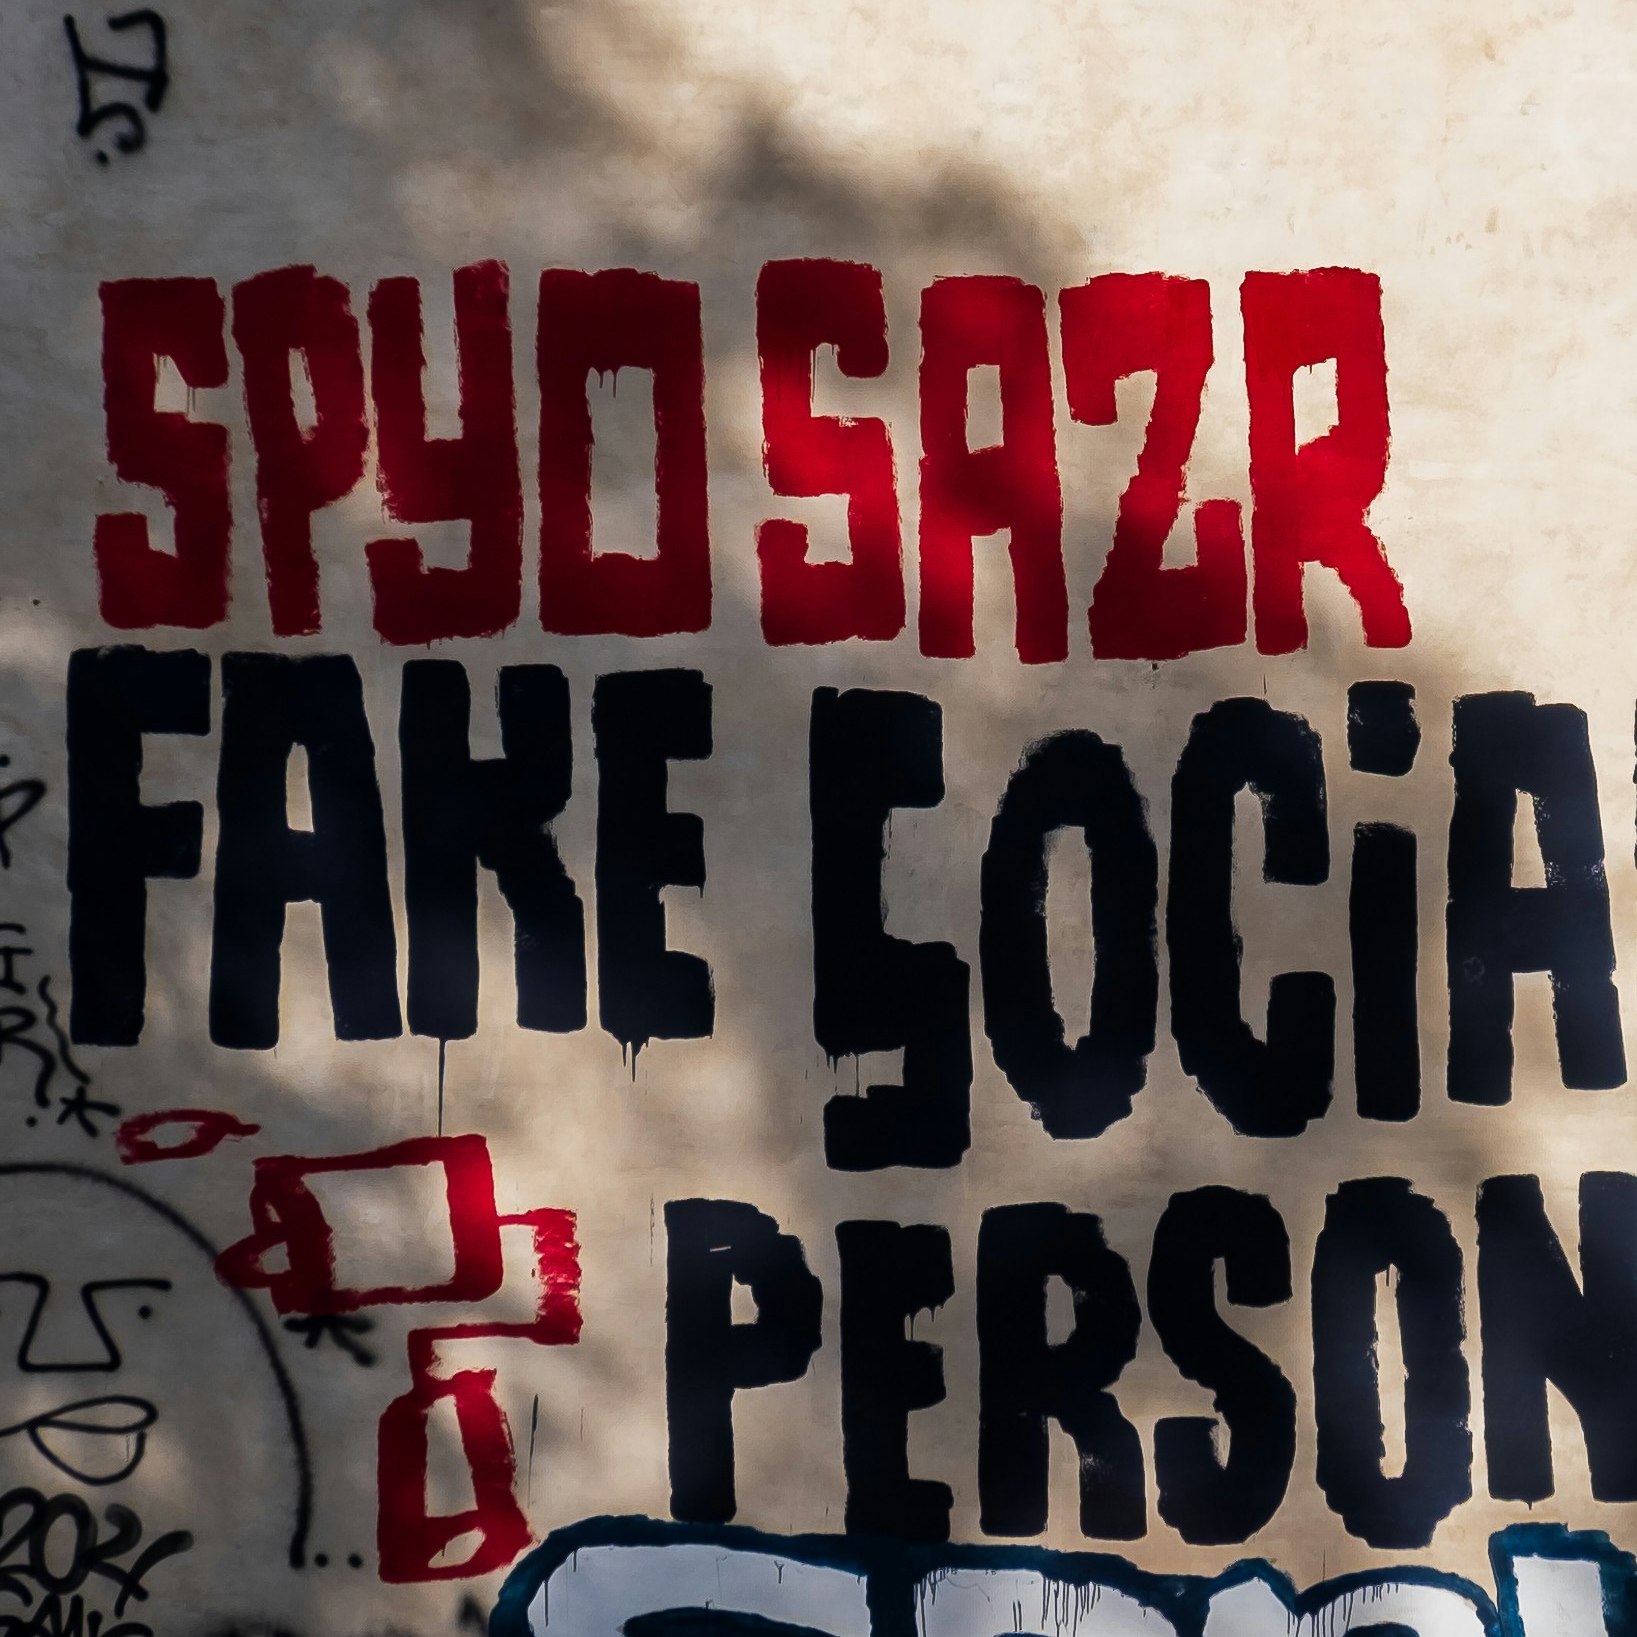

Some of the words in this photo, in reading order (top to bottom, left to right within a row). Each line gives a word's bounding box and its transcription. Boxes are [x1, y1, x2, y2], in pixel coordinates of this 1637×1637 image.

[93, 259, 712, 646] SPYO
[755, 257, 1412, 664] SAZR
[66, 643, 716, 1049] FAKE
